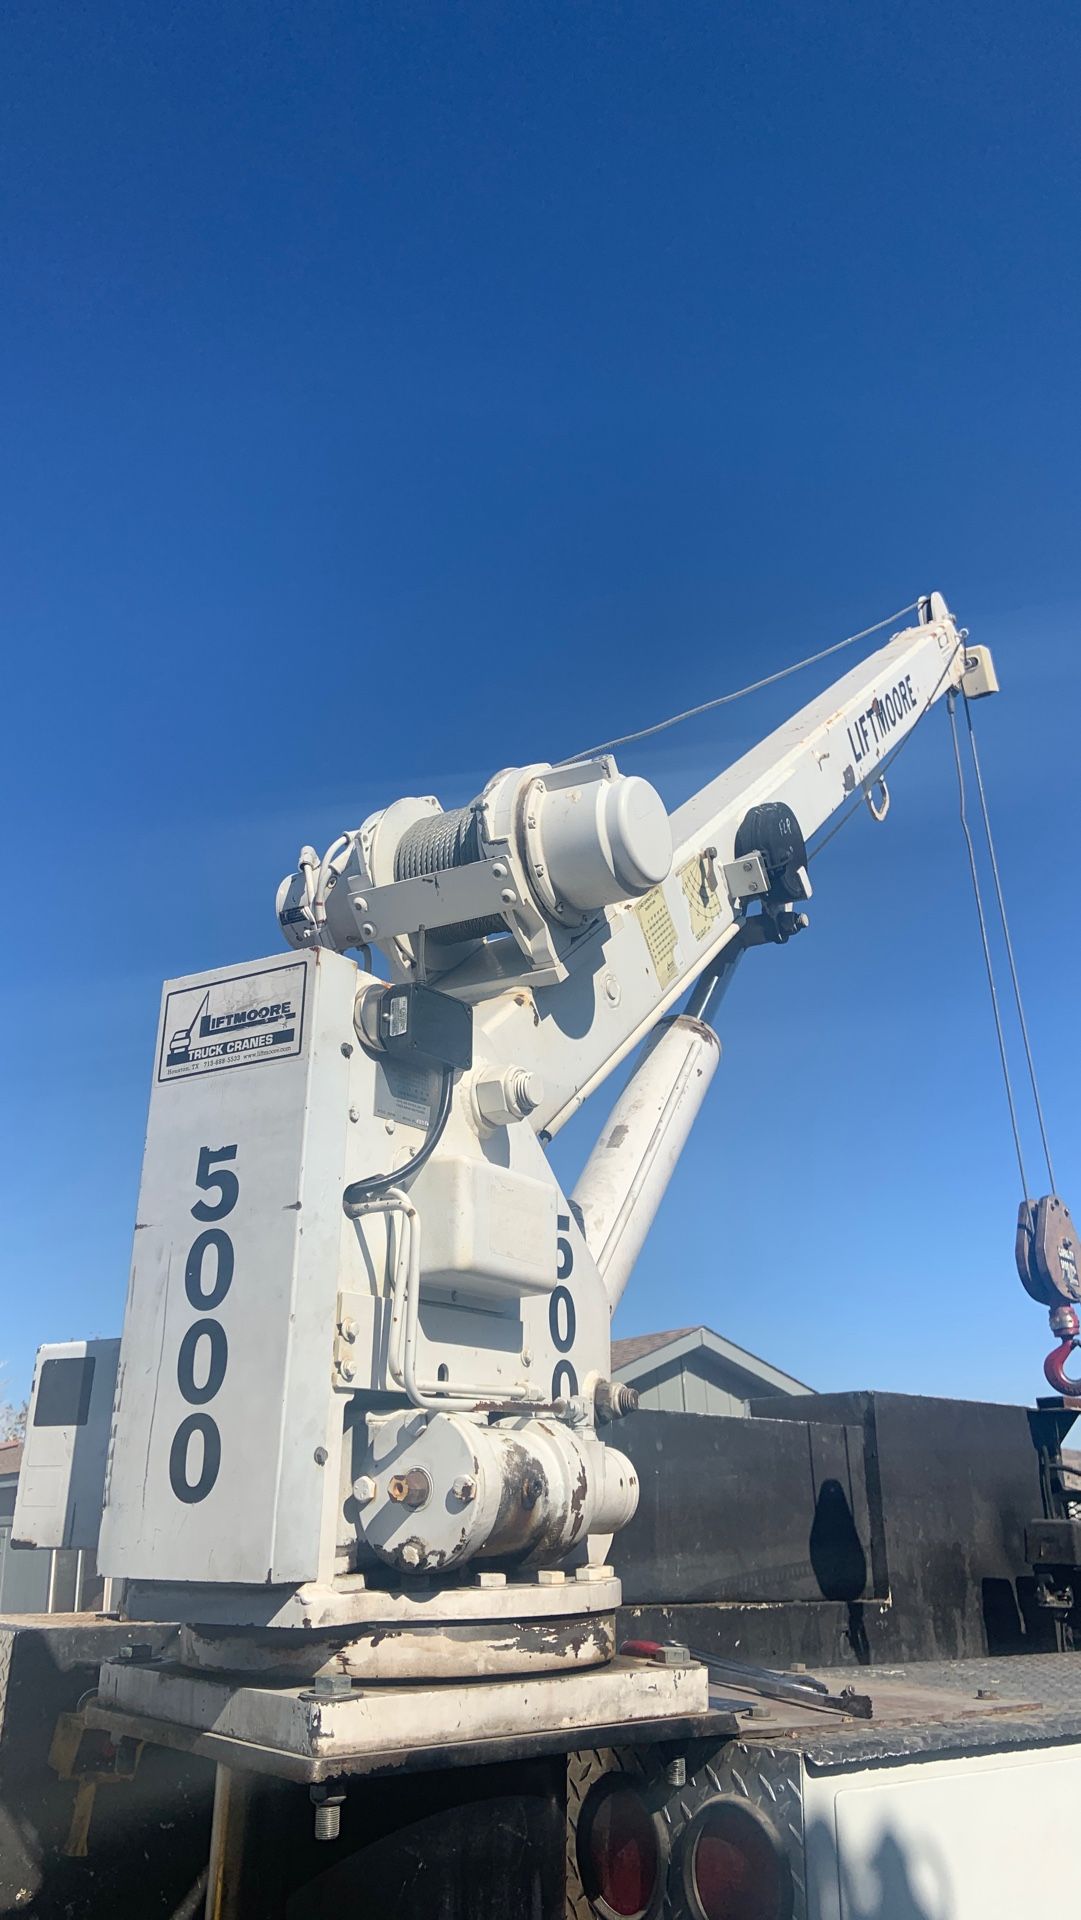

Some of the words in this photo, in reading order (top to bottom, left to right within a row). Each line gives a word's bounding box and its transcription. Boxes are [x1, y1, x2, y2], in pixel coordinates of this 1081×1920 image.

[847, 674, 917, 763] LIFTMOORE
[188, 1044, 224, 1061] TRUCK
[226, 1034, 273, 1053] CRANES
[199, 1002, 295, 1038] LIFTMOORE
[169, 1144, 240, 1504] 5000
